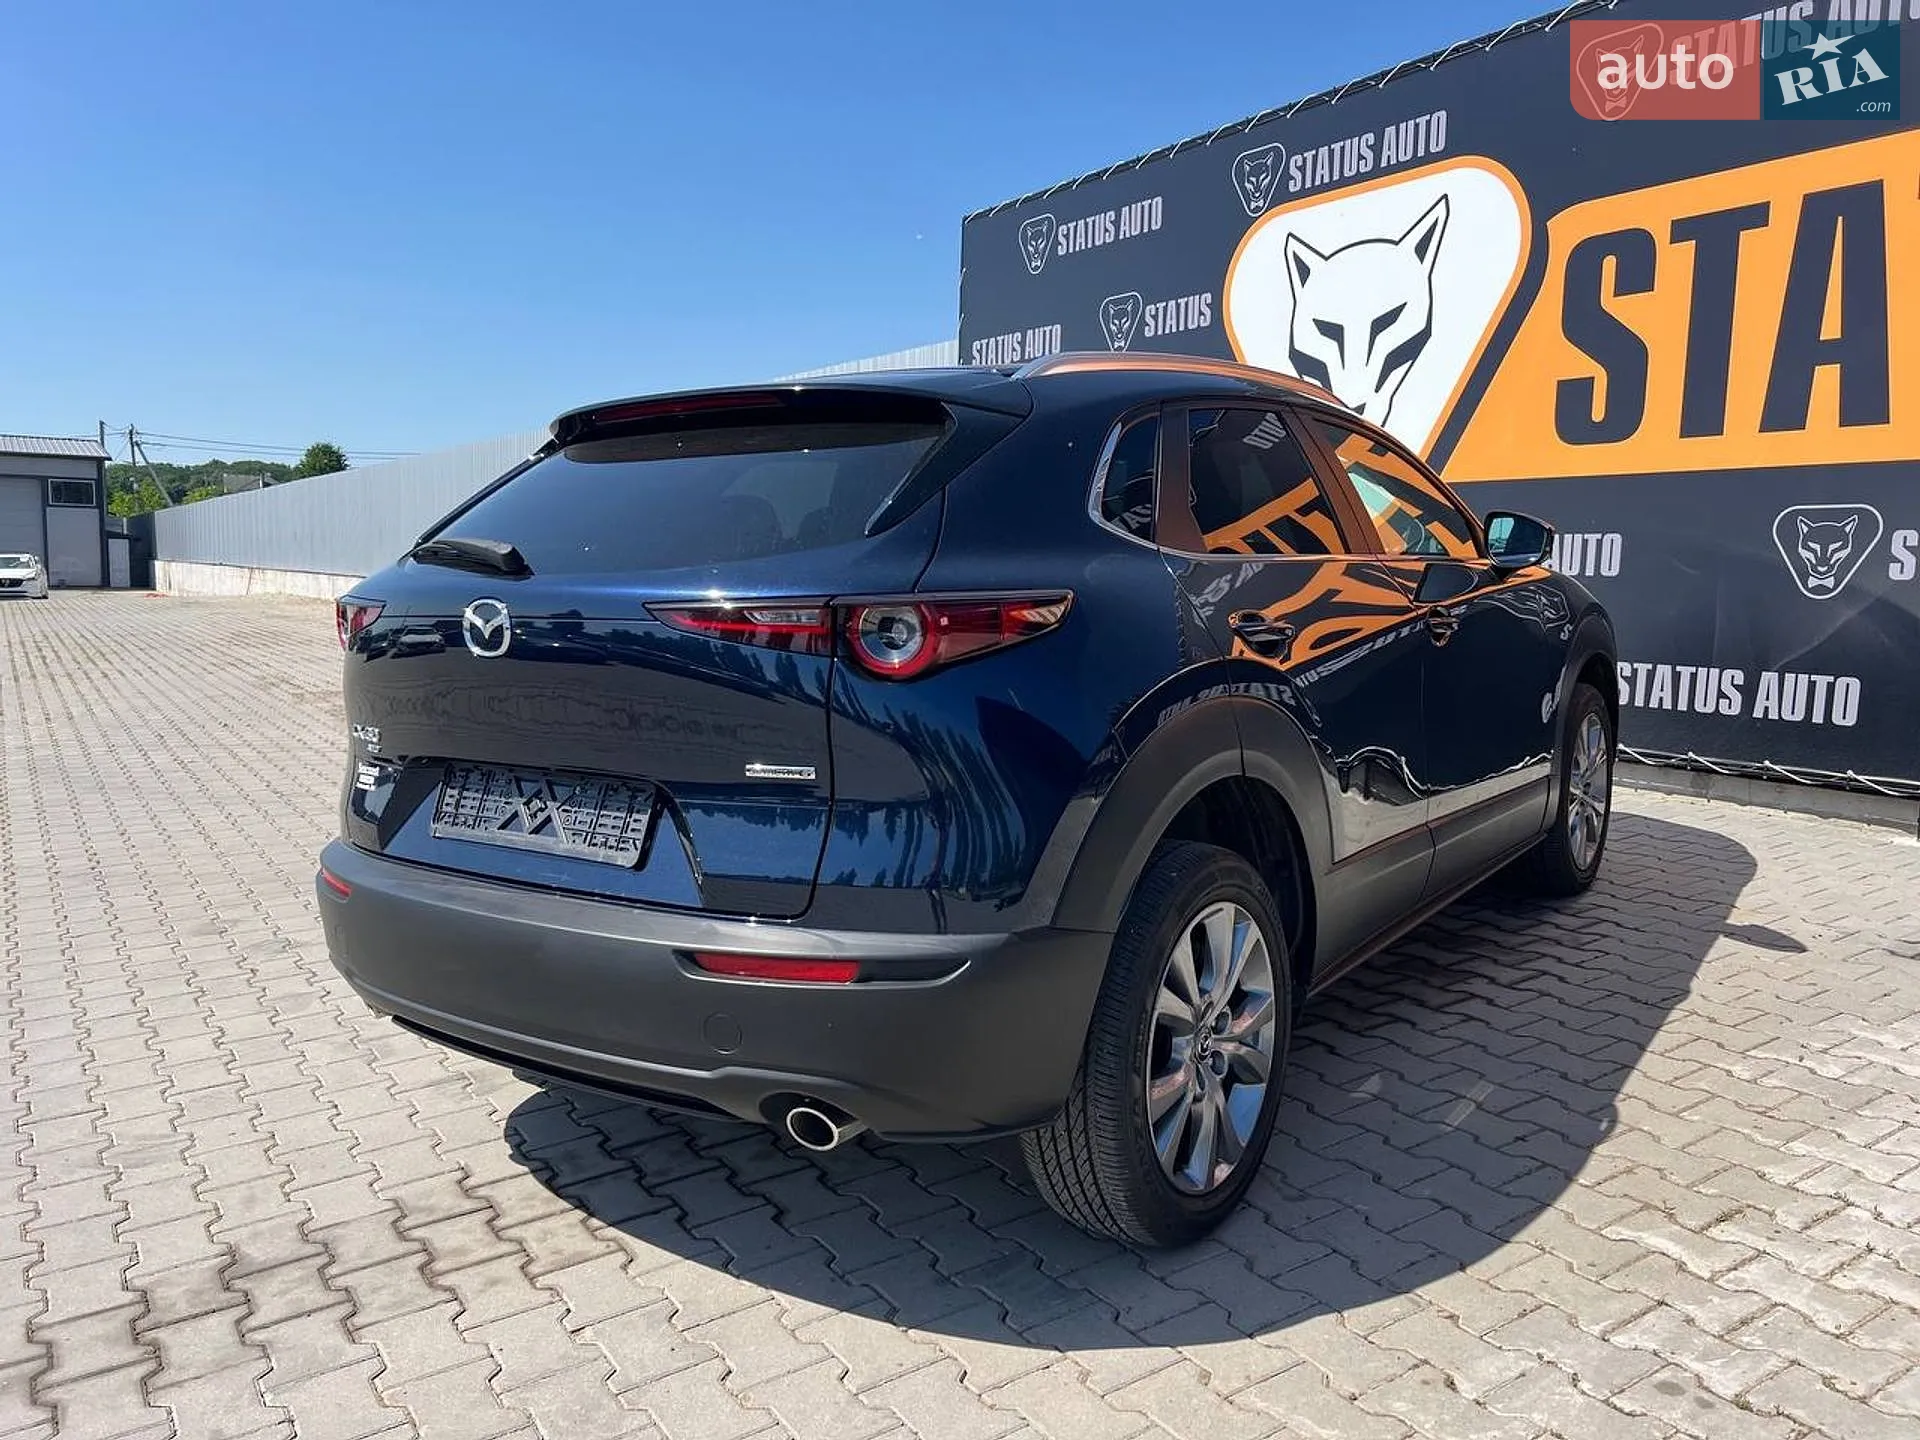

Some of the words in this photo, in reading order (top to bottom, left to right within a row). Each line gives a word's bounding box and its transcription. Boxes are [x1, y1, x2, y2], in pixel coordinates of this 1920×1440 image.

[1825, 0, 1920, 43] AU
[1288, 132, 1375, 193] STATUS
[1380, 110, 1448, 168] AUTO
[1057, 210, 1116, 256] STATUS
[1118, 196, 1163, 240] AUTO
[1144, 293, 1212, 338] STATUS
[1554, 179, 1920, 446] STA
[972, 331, 1022, 365] STATUS
[1024, 324, 1062, 359] AUTO
[1540, 533, 1622, 577] AUTO
[1617, 661, 1744, 716] STATUS
[1752, 671, 1862, 727] AUTO
